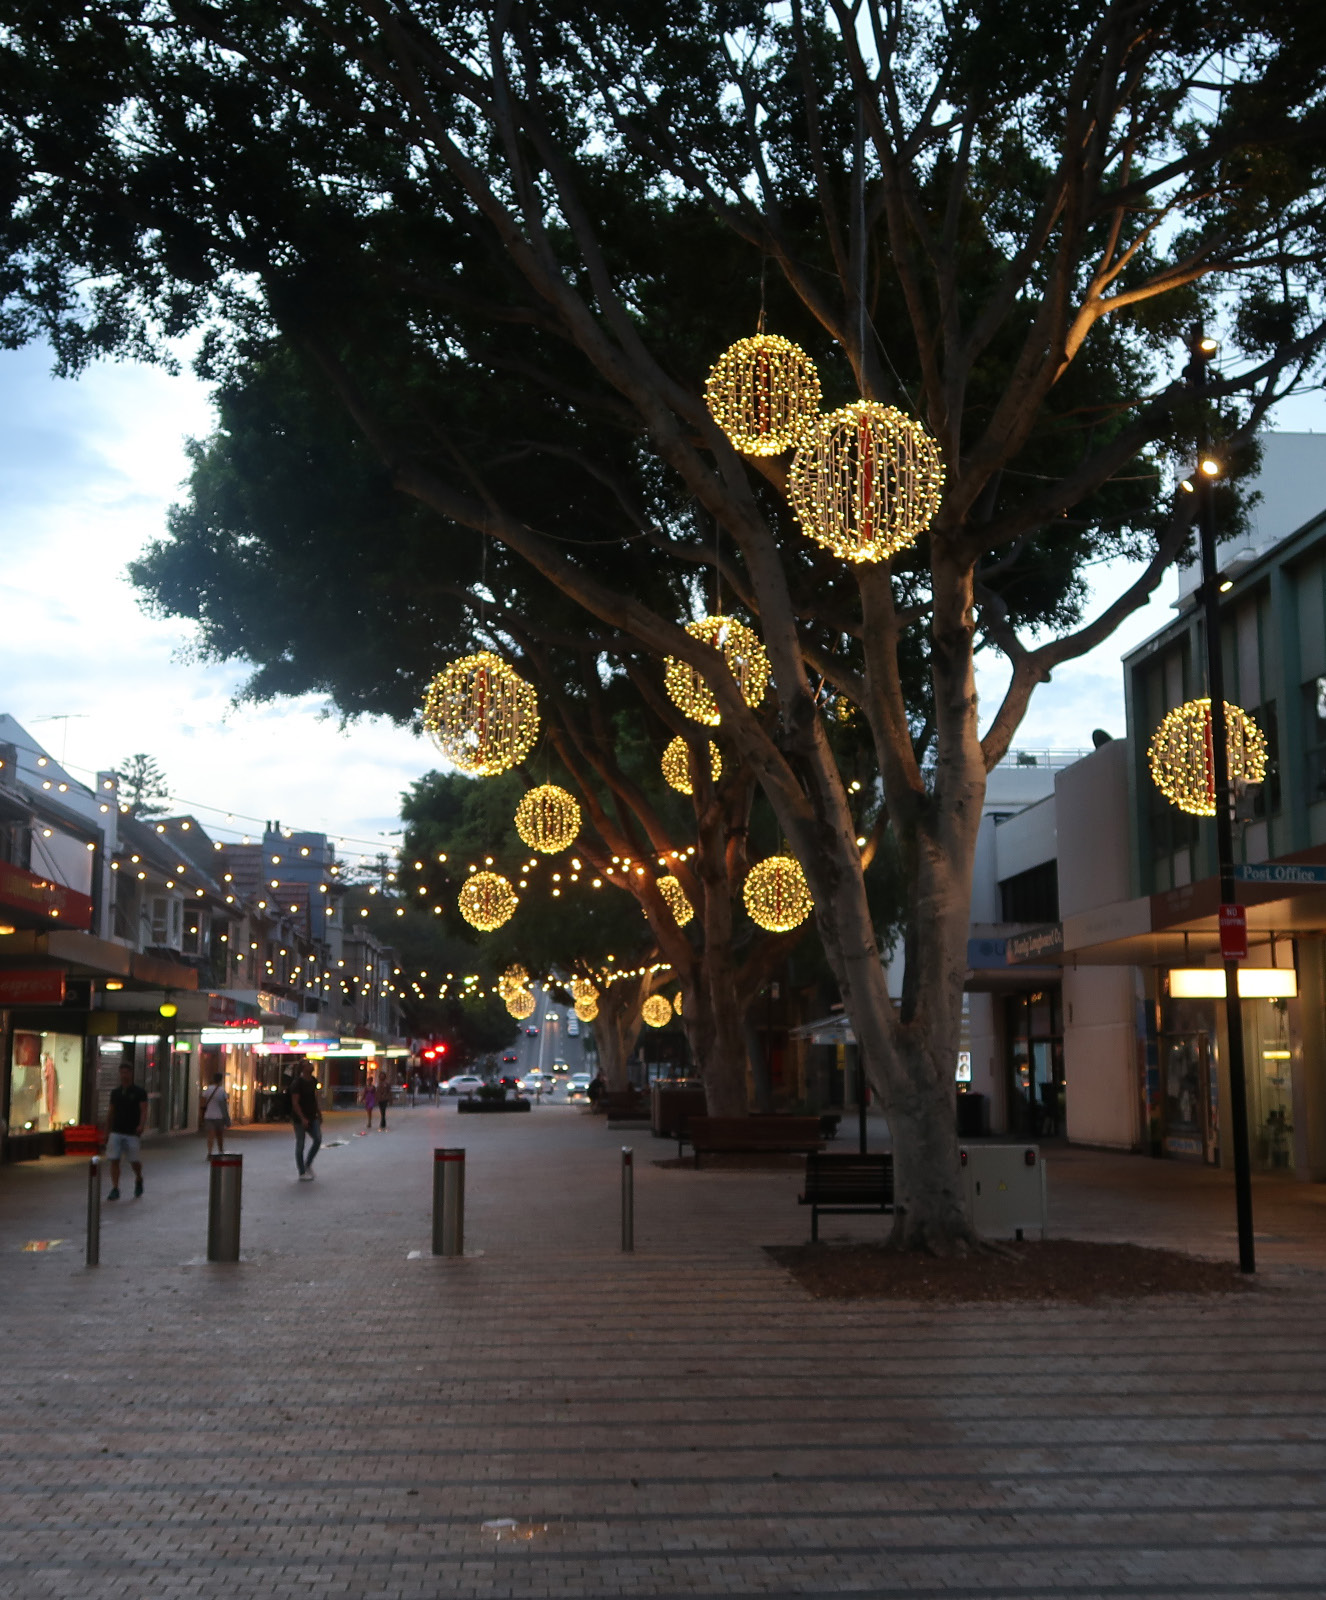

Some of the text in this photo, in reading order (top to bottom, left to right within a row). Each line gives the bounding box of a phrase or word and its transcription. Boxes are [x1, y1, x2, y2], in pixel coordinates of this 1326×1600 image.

[1243, 865, 1315, 882] Post Office
[1226, 908, 1238, 917] NO
